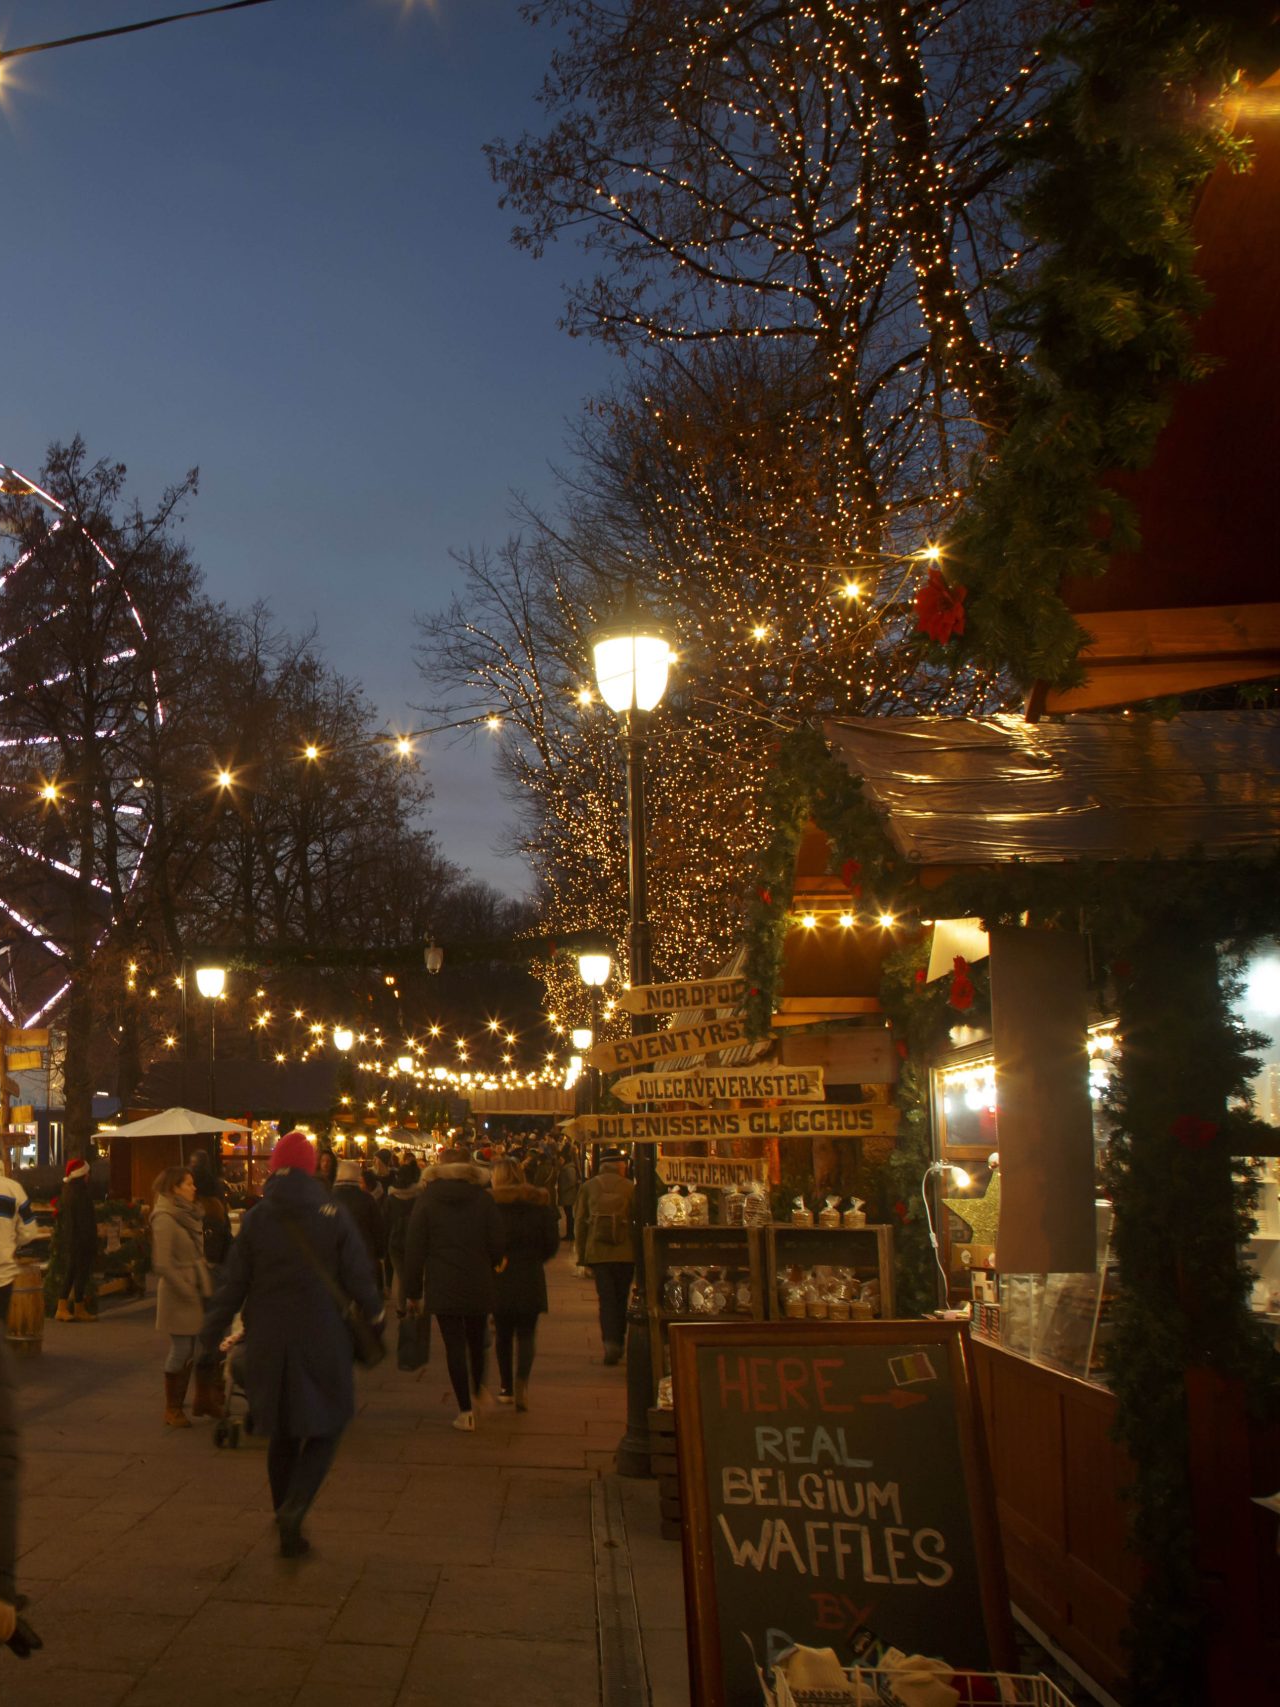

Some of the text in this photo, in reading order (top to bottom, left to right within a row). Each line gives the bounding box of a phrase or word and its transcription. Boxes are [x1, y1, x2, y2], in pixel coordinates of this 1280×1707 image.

[637, 1074, 809, 1099] JULEGAVEVERKSTED
[589, 1109, 873, 1138] JULENISSENS GLØGGHUS
[666, 1161, 753, 1185] JULESTJERNEN
[717, 1355, 855, 1412] HERE
[755, 1426, 873, 1467] REAL
[716, 1514, 953, 1587] WAFFLES
[809, 1593, 877, 1635] BY
